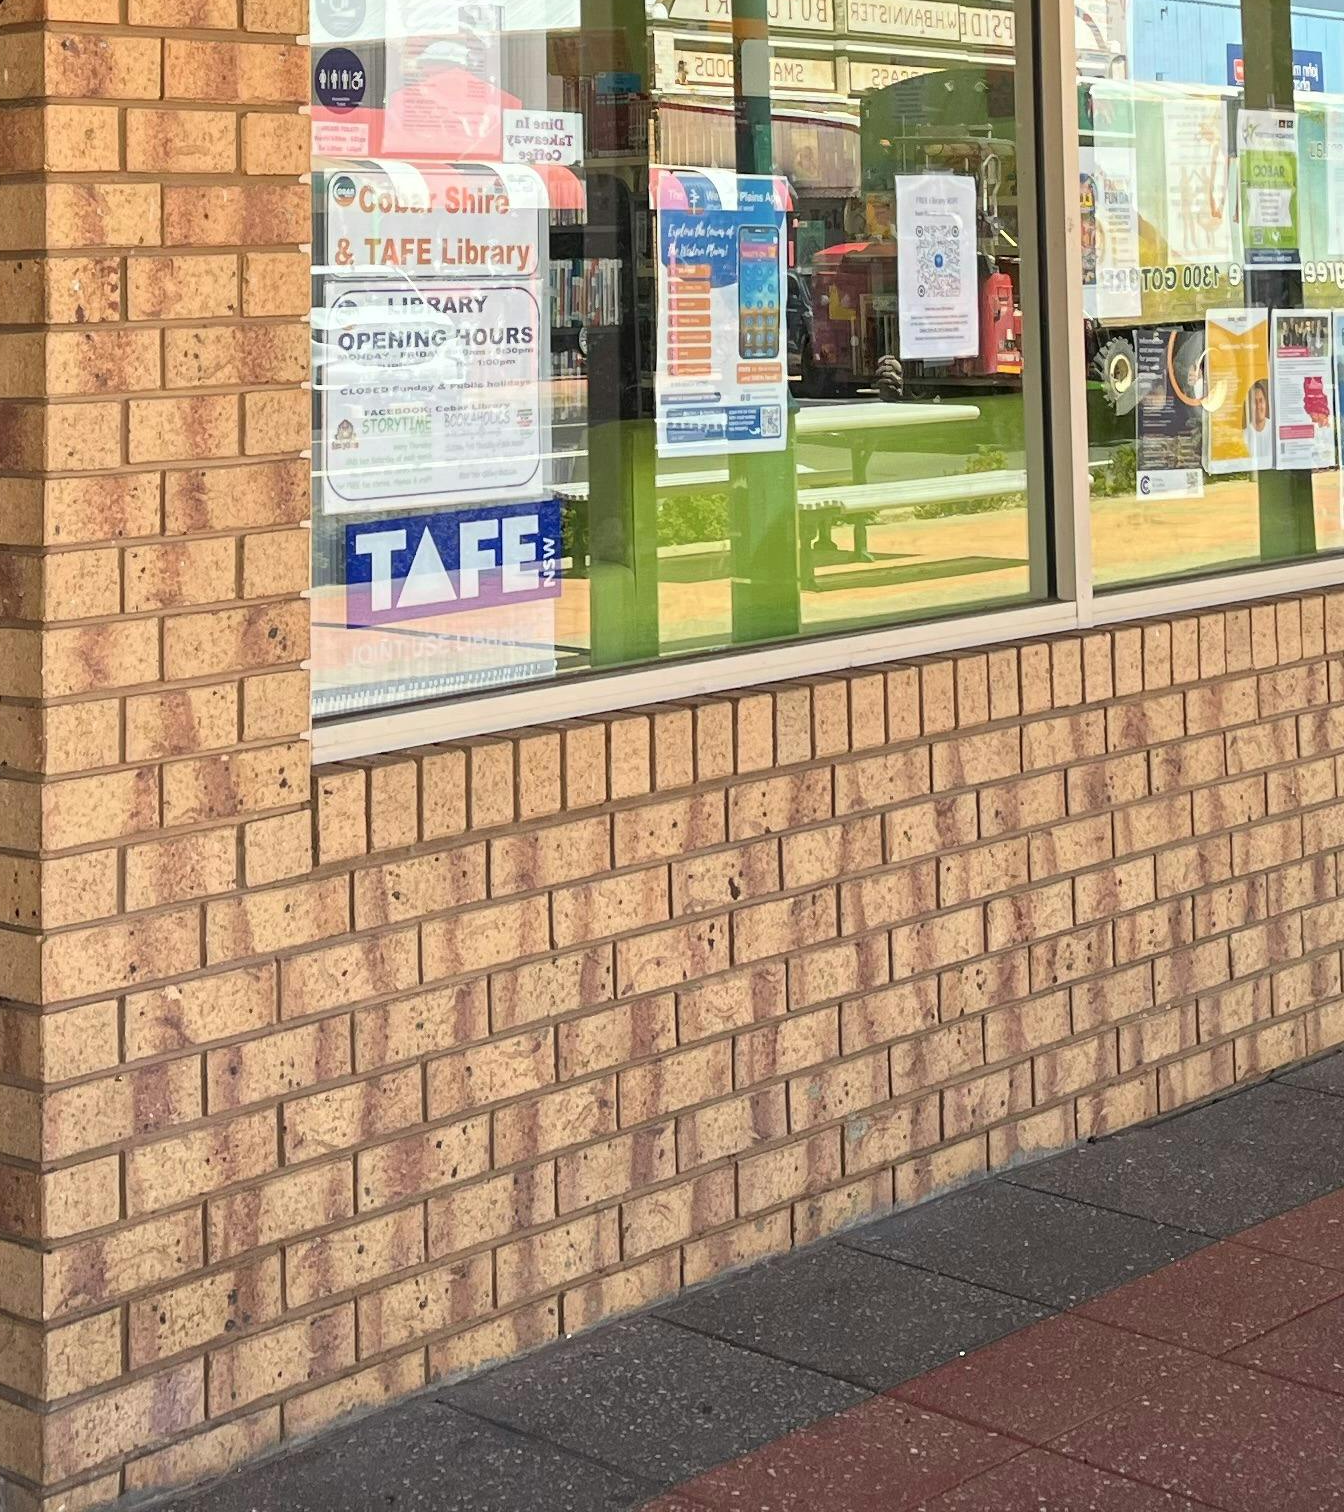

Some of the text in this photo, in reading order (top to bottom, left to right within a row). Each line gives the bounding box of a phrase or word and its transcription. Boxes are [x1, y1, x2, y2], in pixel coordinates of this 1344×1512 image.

[358, 184, 510, 215] Cobar Shire
[334, 237, 530, 272] & TAFE Library
[387, 295, 489, 315] LIBRARY
[337, 329, 447, 352] OPENING
[455, 326, 534, 347] HOURS
[340, 386, 388, 396] CLOSED
[362, 413, 432, 435] STORYTIME
[355, 513, 539, 613] TAFE
[543, 536, 556, 589] NSW
[352, 638, 407, 666] JOINT
